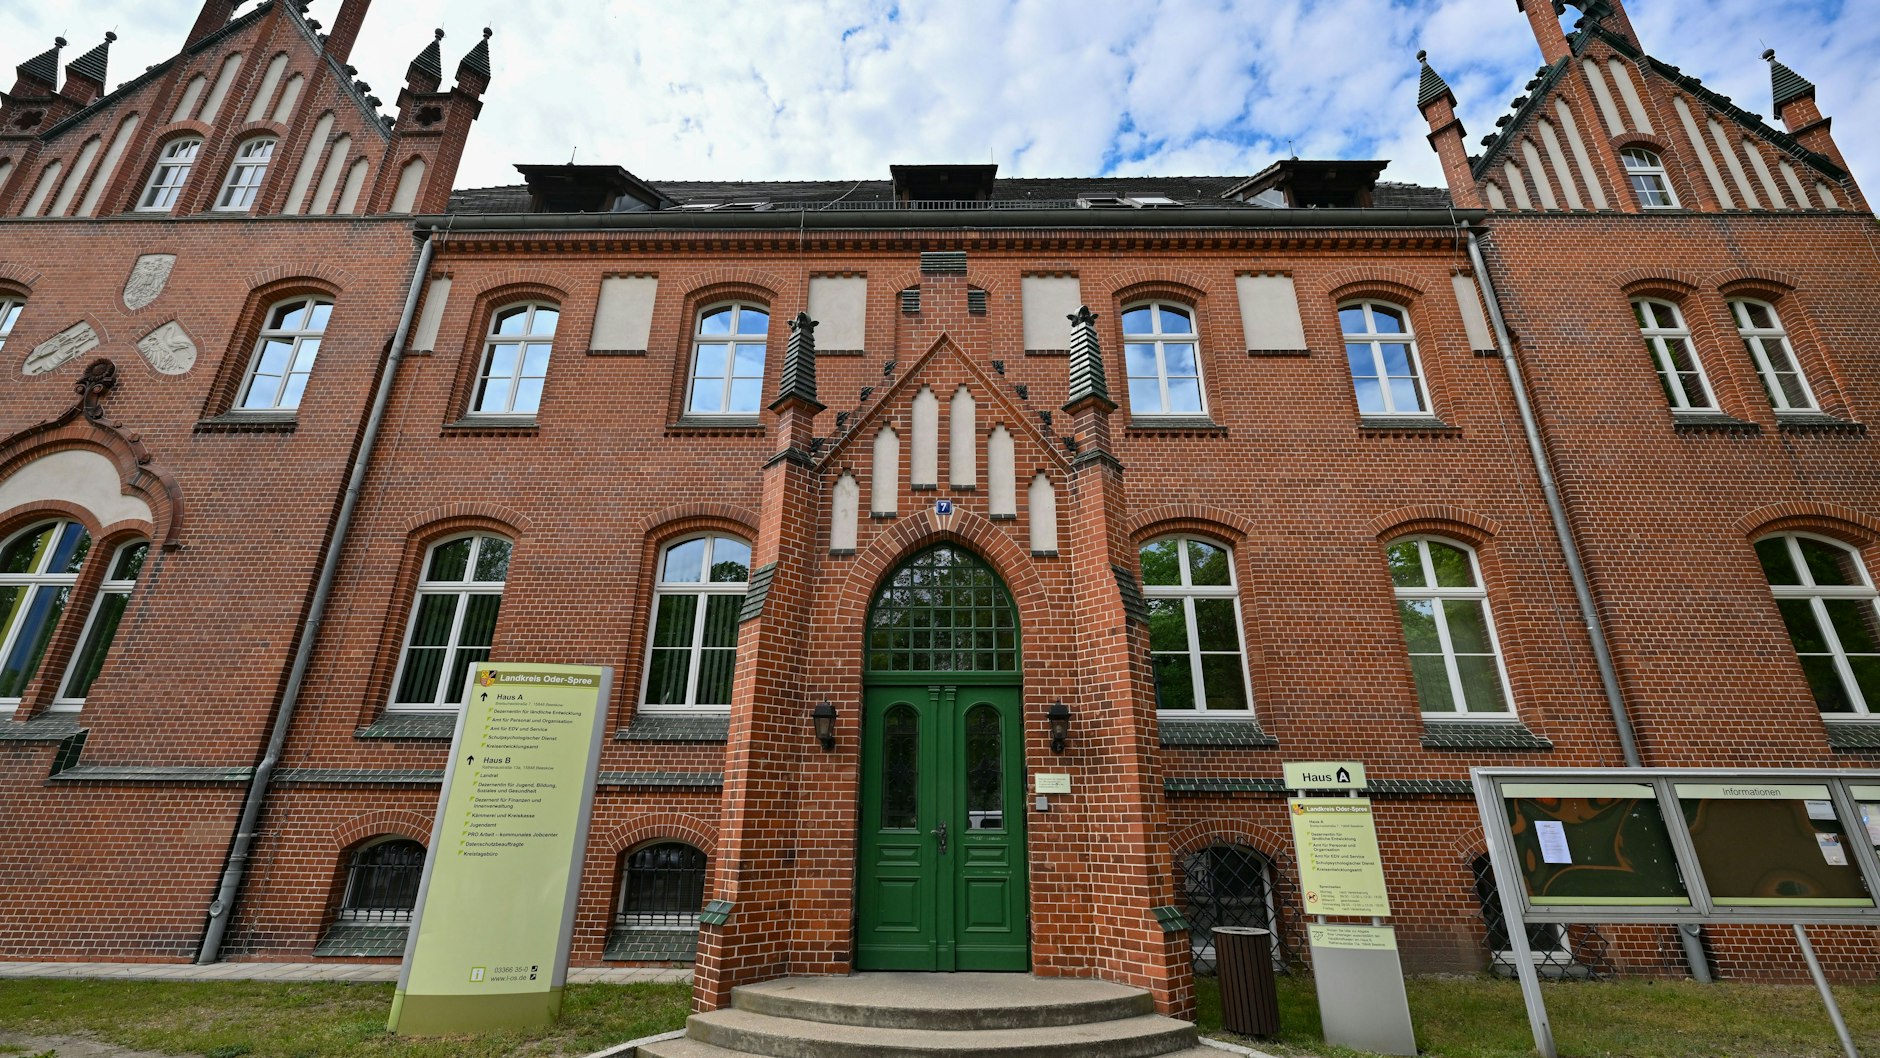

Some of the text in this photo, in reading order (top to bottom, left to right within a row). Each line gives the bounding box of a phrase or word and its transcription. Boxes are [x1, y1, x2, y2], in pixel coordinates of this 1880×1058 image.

[941, 503, 947, 511] 7
[500, 674, 592, 685] Landkreis Oder-Spree
[1303, 772, 1348, 781] Haus A
[490, 974, 527, 982] www.l-os.de
